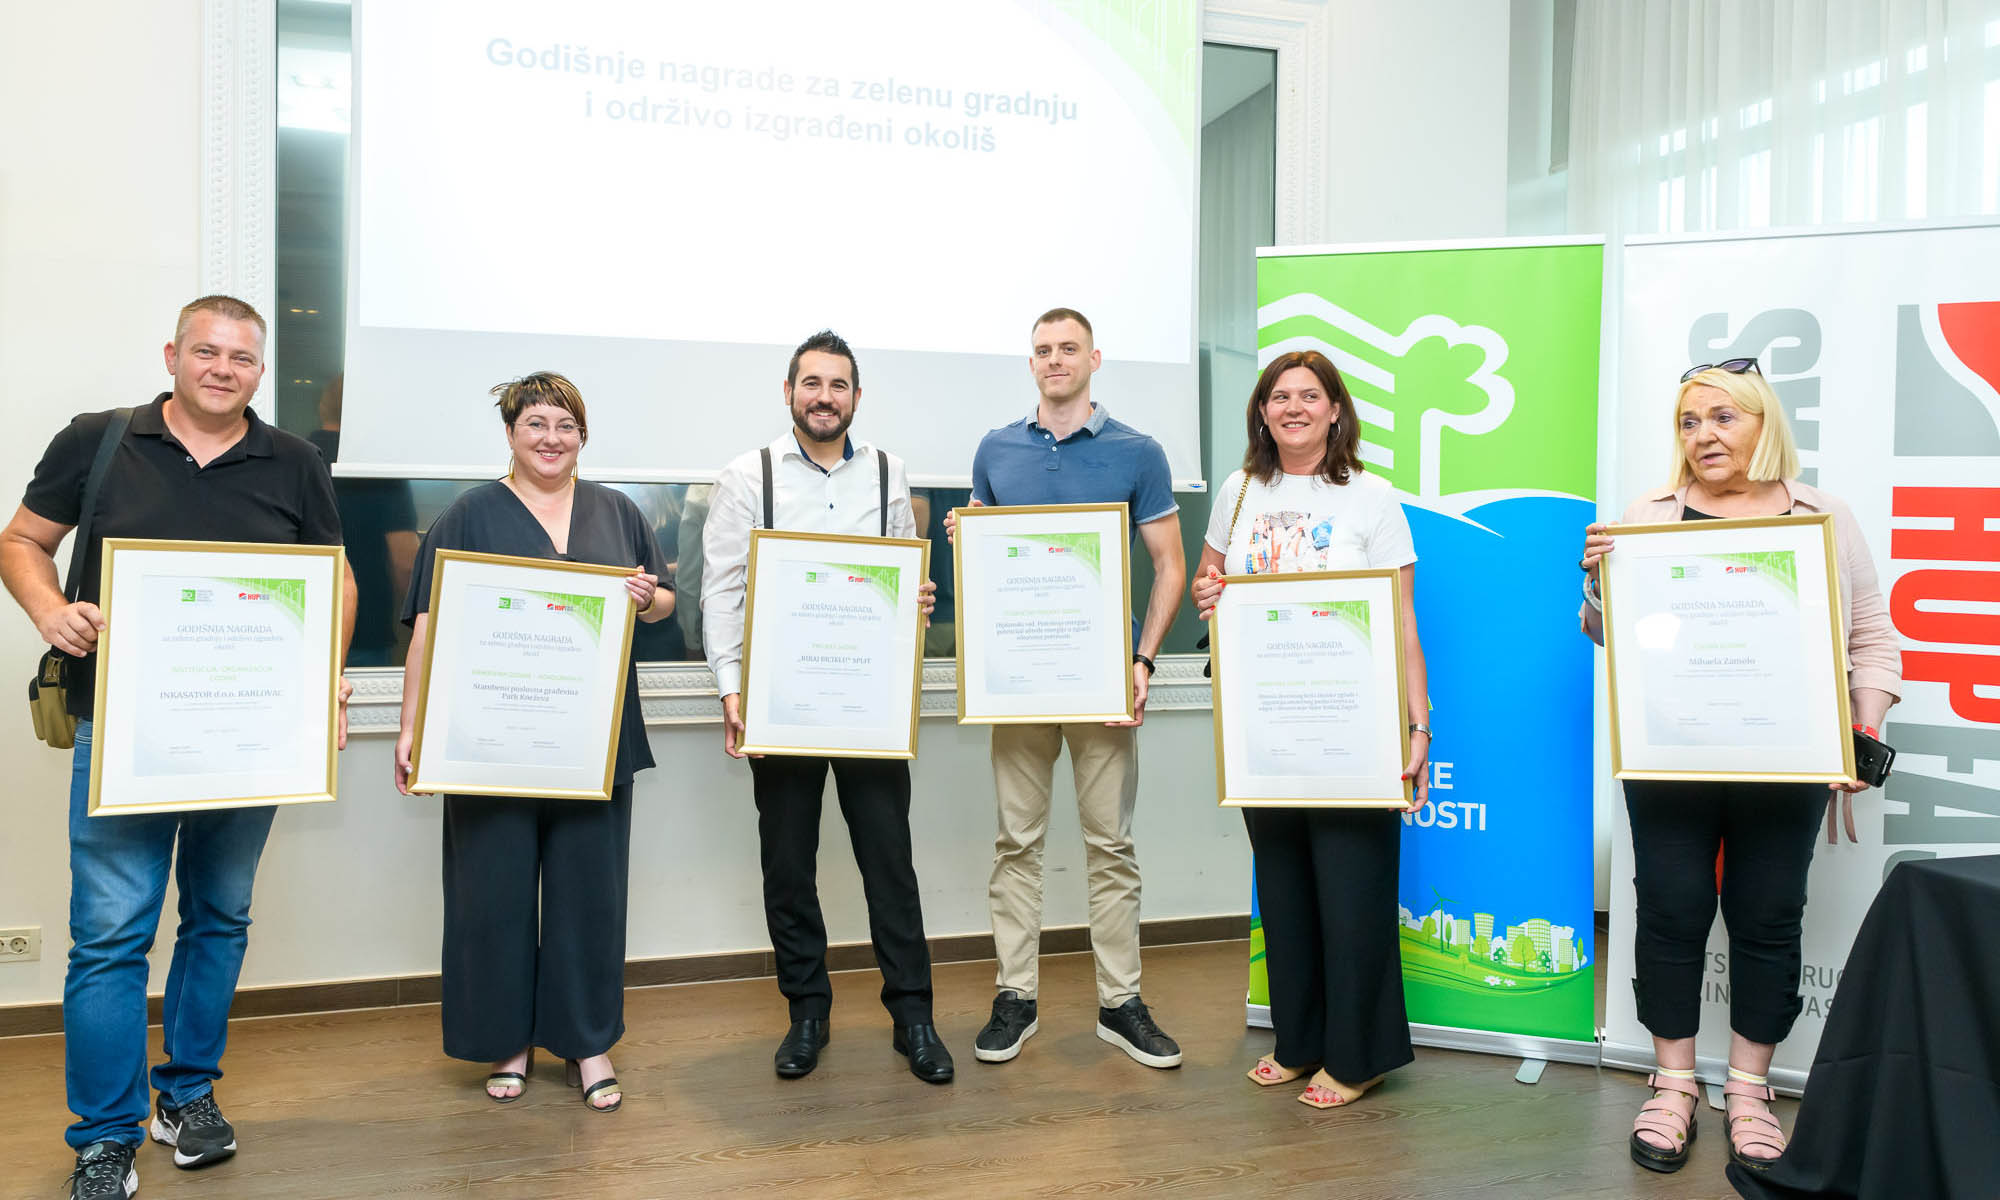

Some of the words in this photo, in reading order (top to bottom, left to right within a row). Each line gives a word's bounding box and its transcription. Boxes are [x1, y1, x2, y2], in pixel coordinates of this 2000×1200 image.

[486, 38, 645, 84] Godišnje
[659, 59, 795, 94] nagrade
[805, 74, 840, 98] za
[851, 77, 953, 109] zelenu
[963, 90, 1079, 125] gradnju
[584, 91, 593, 117] i
[605, 94, 733, 129] održivo
[744, 106, 893, 143] izgrađeni
[903, 122, 997, 152] okoliš
[1688, 656, 1722, 665] Mihaela
[1883, 485, 2000, 884] HUPFA
